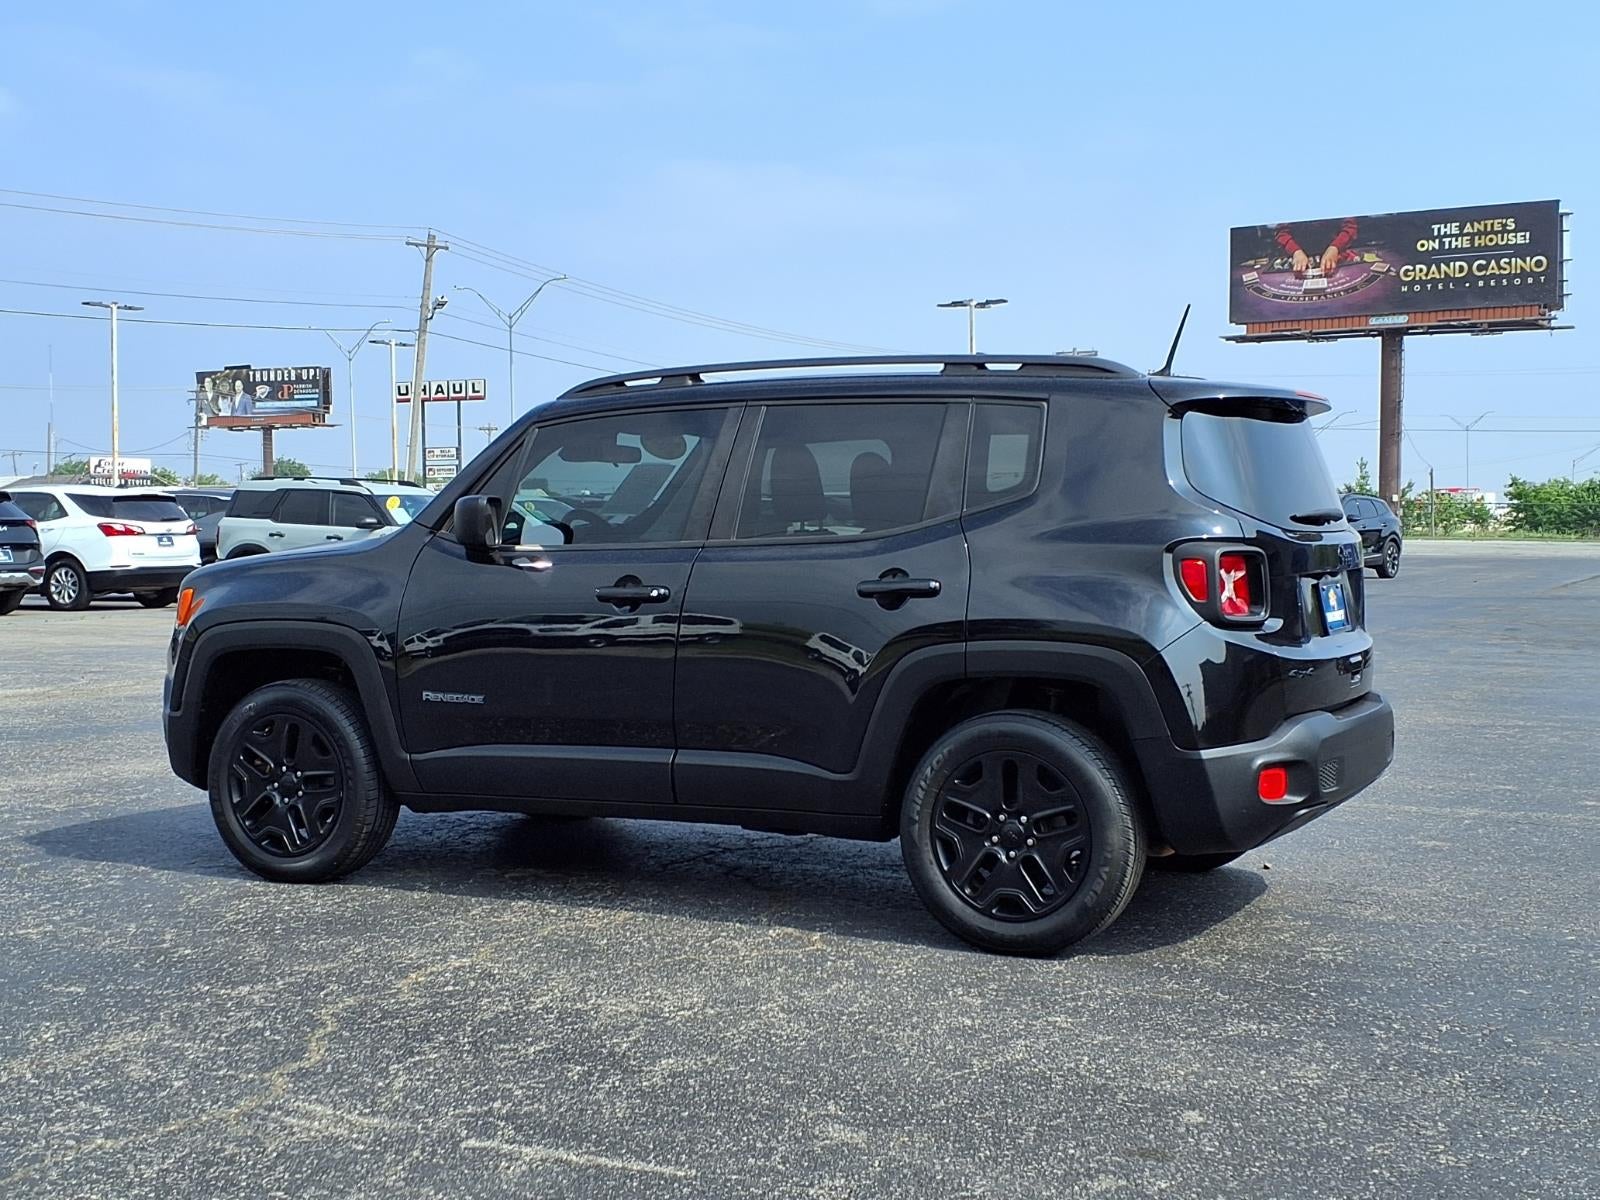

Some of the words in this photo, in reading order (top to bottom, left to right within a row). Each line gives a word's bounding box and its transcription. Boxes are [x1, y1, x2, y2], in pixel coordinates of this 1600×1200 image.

[1431, 222, 1460, 236] THE
[1463, 218, 1516, 234] ANTE'S
[1416, 239, 1439, 252] ON
[1442, 236, 1471, 250] THE
[1474, 231, 1530, 248] HOUSE!
[1399, 261, 1468, 281] GRAND
[1472, 255, 1548, 276] CASINO
[1401, 282, 1455, 292] HOTEL
[1478, 275, 1546, 287] RESORT
[249, 369, 296, 382] THUNDER
[302, 368, 320, 380] UP!
[94, 465, 149, 475] Cretions
